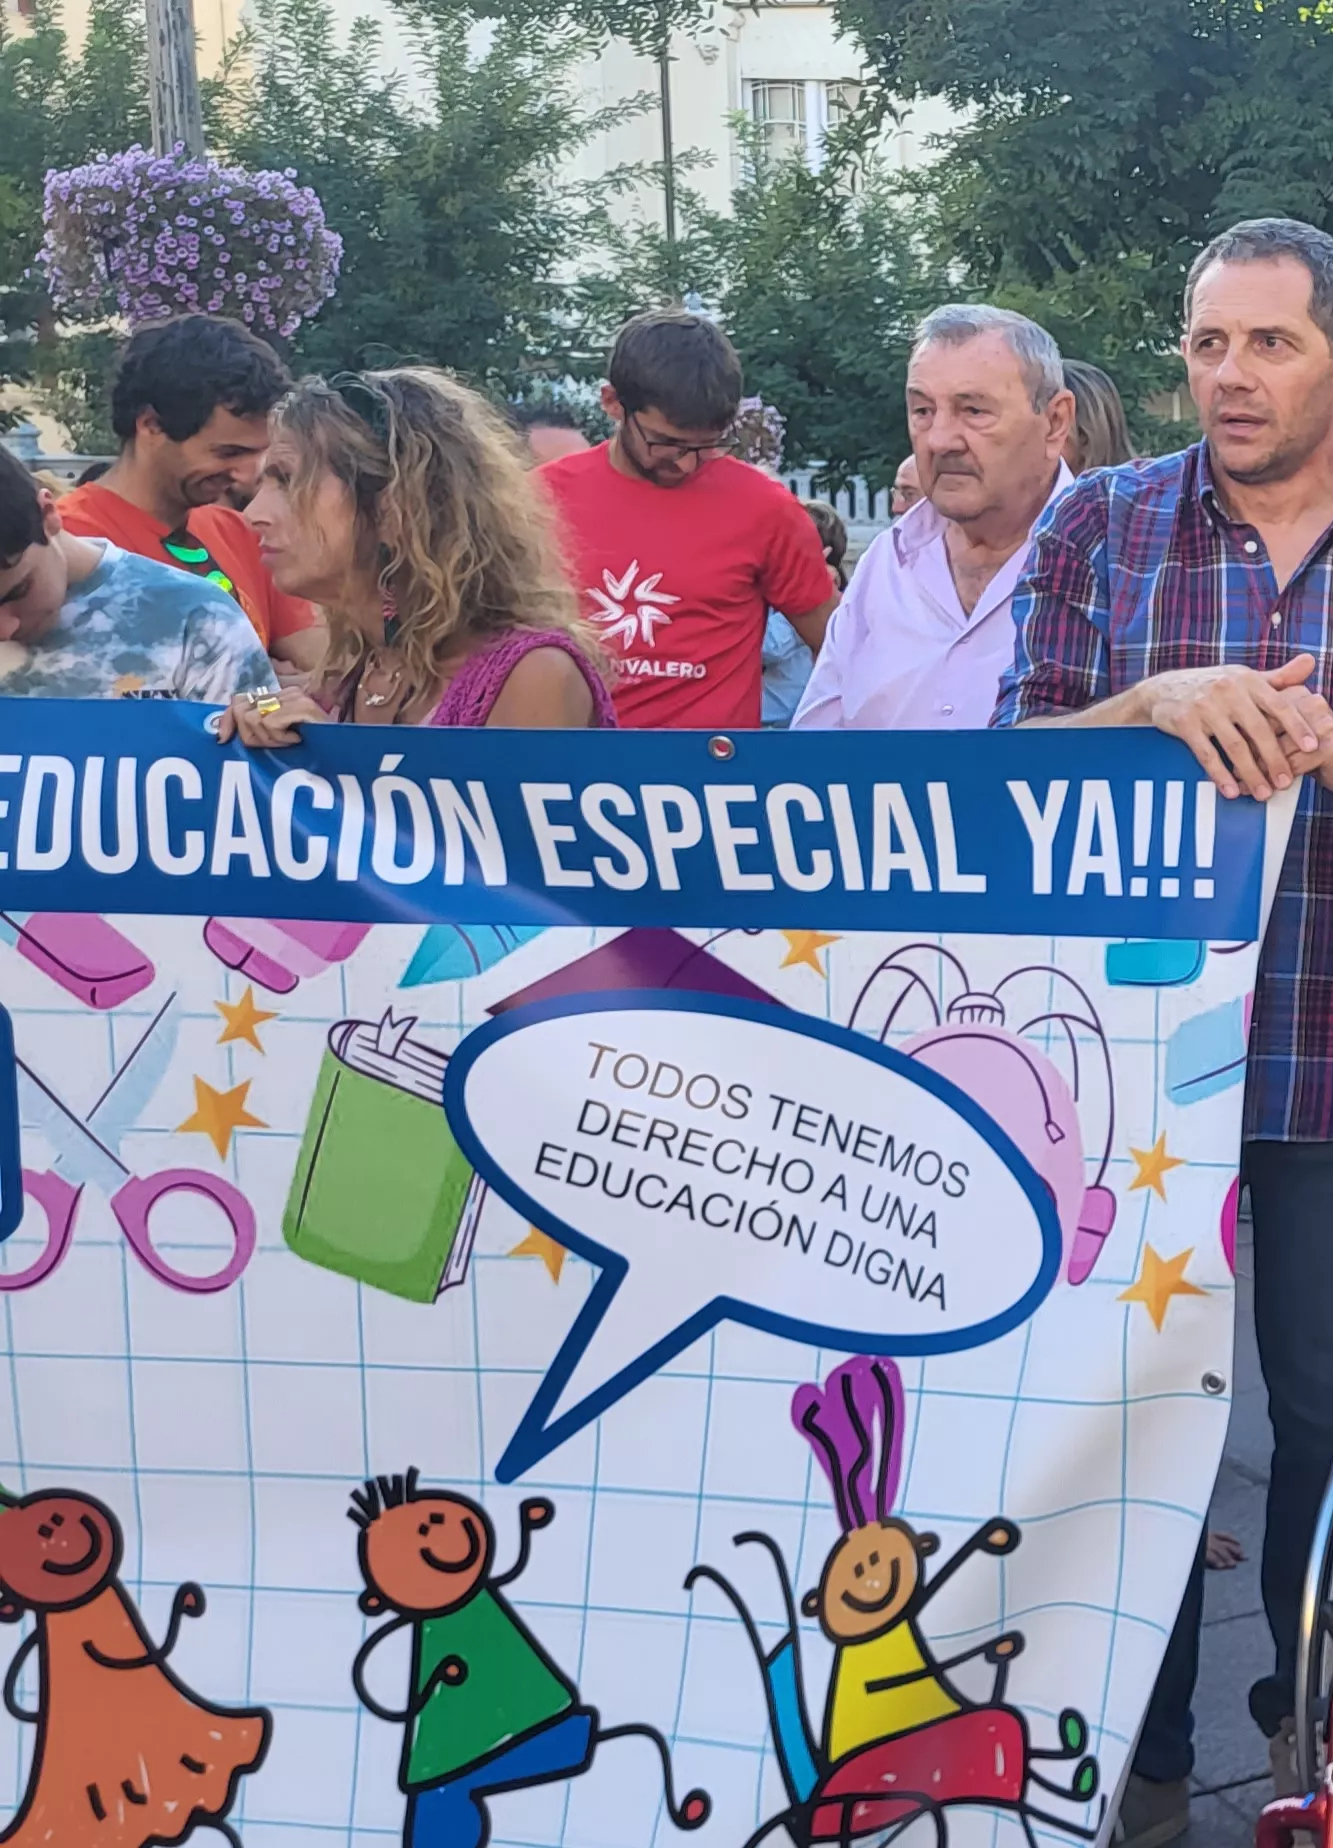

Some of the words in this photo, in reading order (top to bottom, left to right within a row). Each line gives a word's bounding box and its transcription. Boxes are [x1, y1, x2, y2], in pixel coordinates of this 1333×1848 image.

[610, 659, 707, 680] NVALERO
[522, 783, 986, 892] ESPECIAL
[1007, 780, 1216, 898] YA!!!
[577, 1099, 814, 1193] DERECHO
[821, 1174, 846, 1211] A
[861, 1185, 936, 1248] UNA
[588, 1043, 752, 1119] TODOS
[770, 1094, 969, 1197] TENEMOS
[535, 1142, 816, 1254] EDUCACIÓN
[824, 1230, 945, 1311] DIGNA
